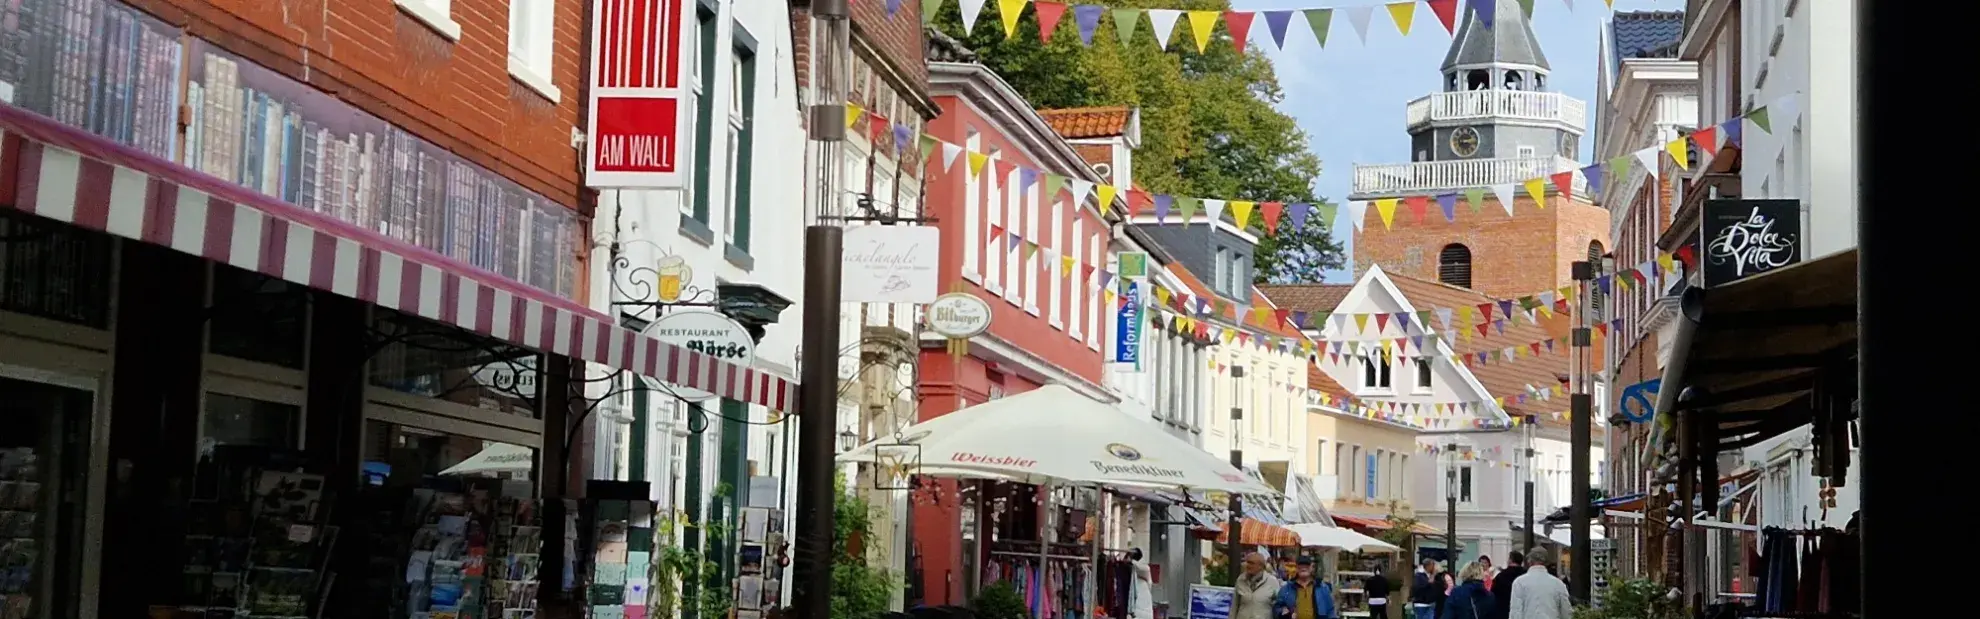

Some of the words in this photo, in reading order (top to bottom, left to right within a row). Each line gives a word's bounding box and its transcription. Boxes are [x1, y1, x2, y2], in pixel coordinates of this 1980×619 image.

[599, 134, 624, 166] AM
[629, 134, 670, 167] WALL
[1713, 218, 1788, 255] Dolce
[1729, 246, 1792, 276] Vita
[936, 305, 981, 325] Bitburger
[951, 451, 1037, 468] Weissbier
[1090, 460, 1185, 478] Benediktiner
